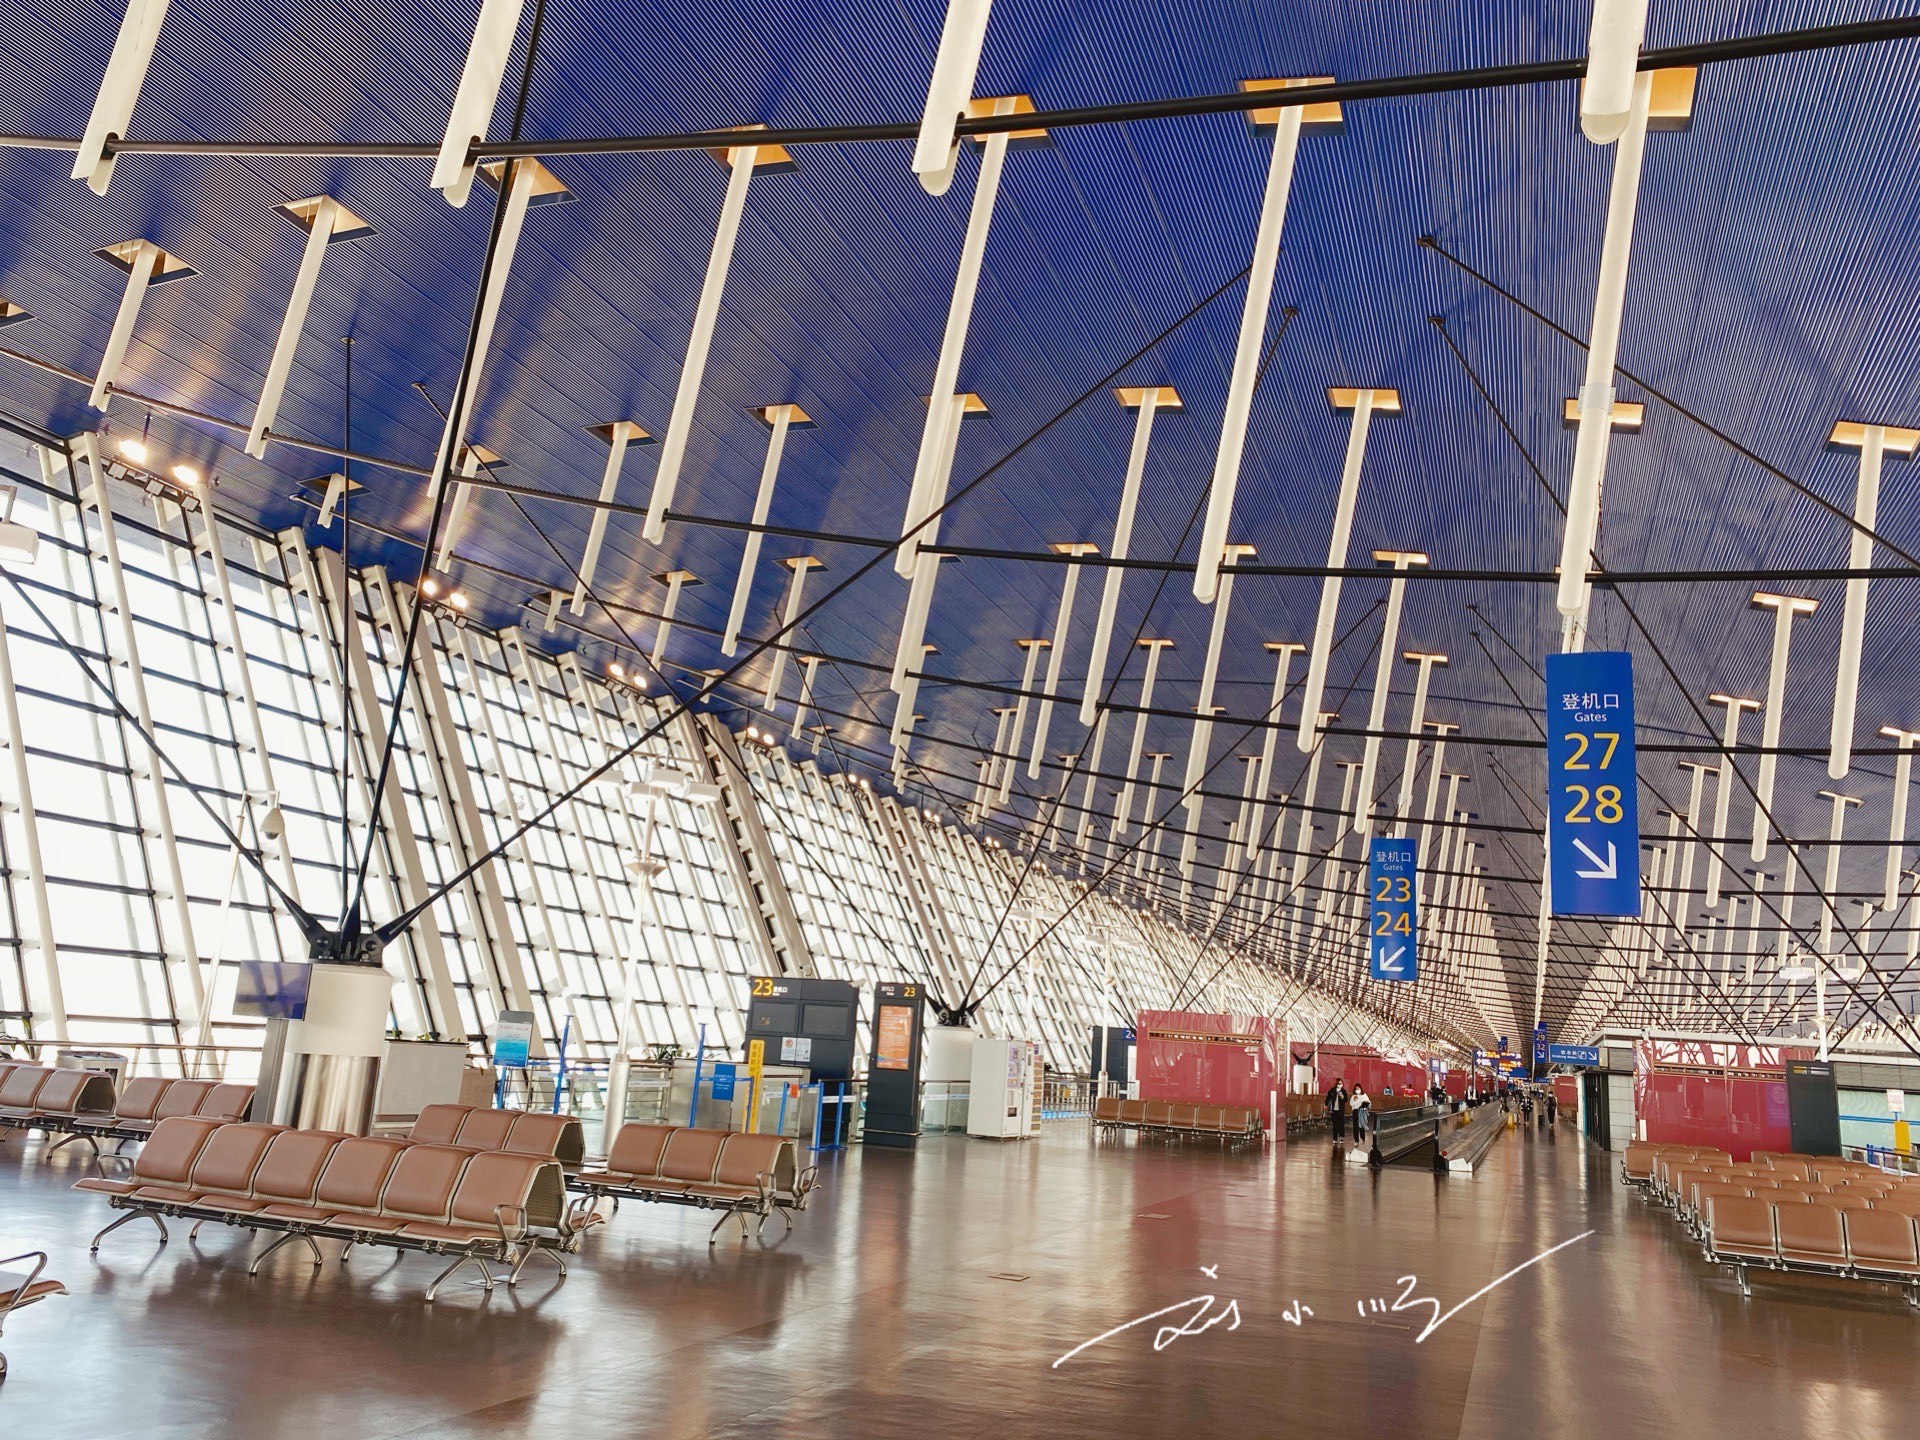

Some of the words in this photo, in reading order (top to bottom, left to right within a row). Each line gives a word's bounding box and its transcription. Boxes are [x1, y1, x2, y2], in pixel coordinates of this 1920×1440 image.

[1562, 693, 1619, 710] 登机口
[1574, 711, 1607, 722] Gates
[1563, 732, 1620, 770] 27
[1564, 784, 1624, 824] 28
[1376, 851, 1411, 863] 登机口
[1383, 863, 1404, 871] Gates
[1376, 877, 1411, 902] 23
[1375, 911, 1412, 937] 24
[752, 979, 773, 996] 23
[903, 986, 916, 998] 23
